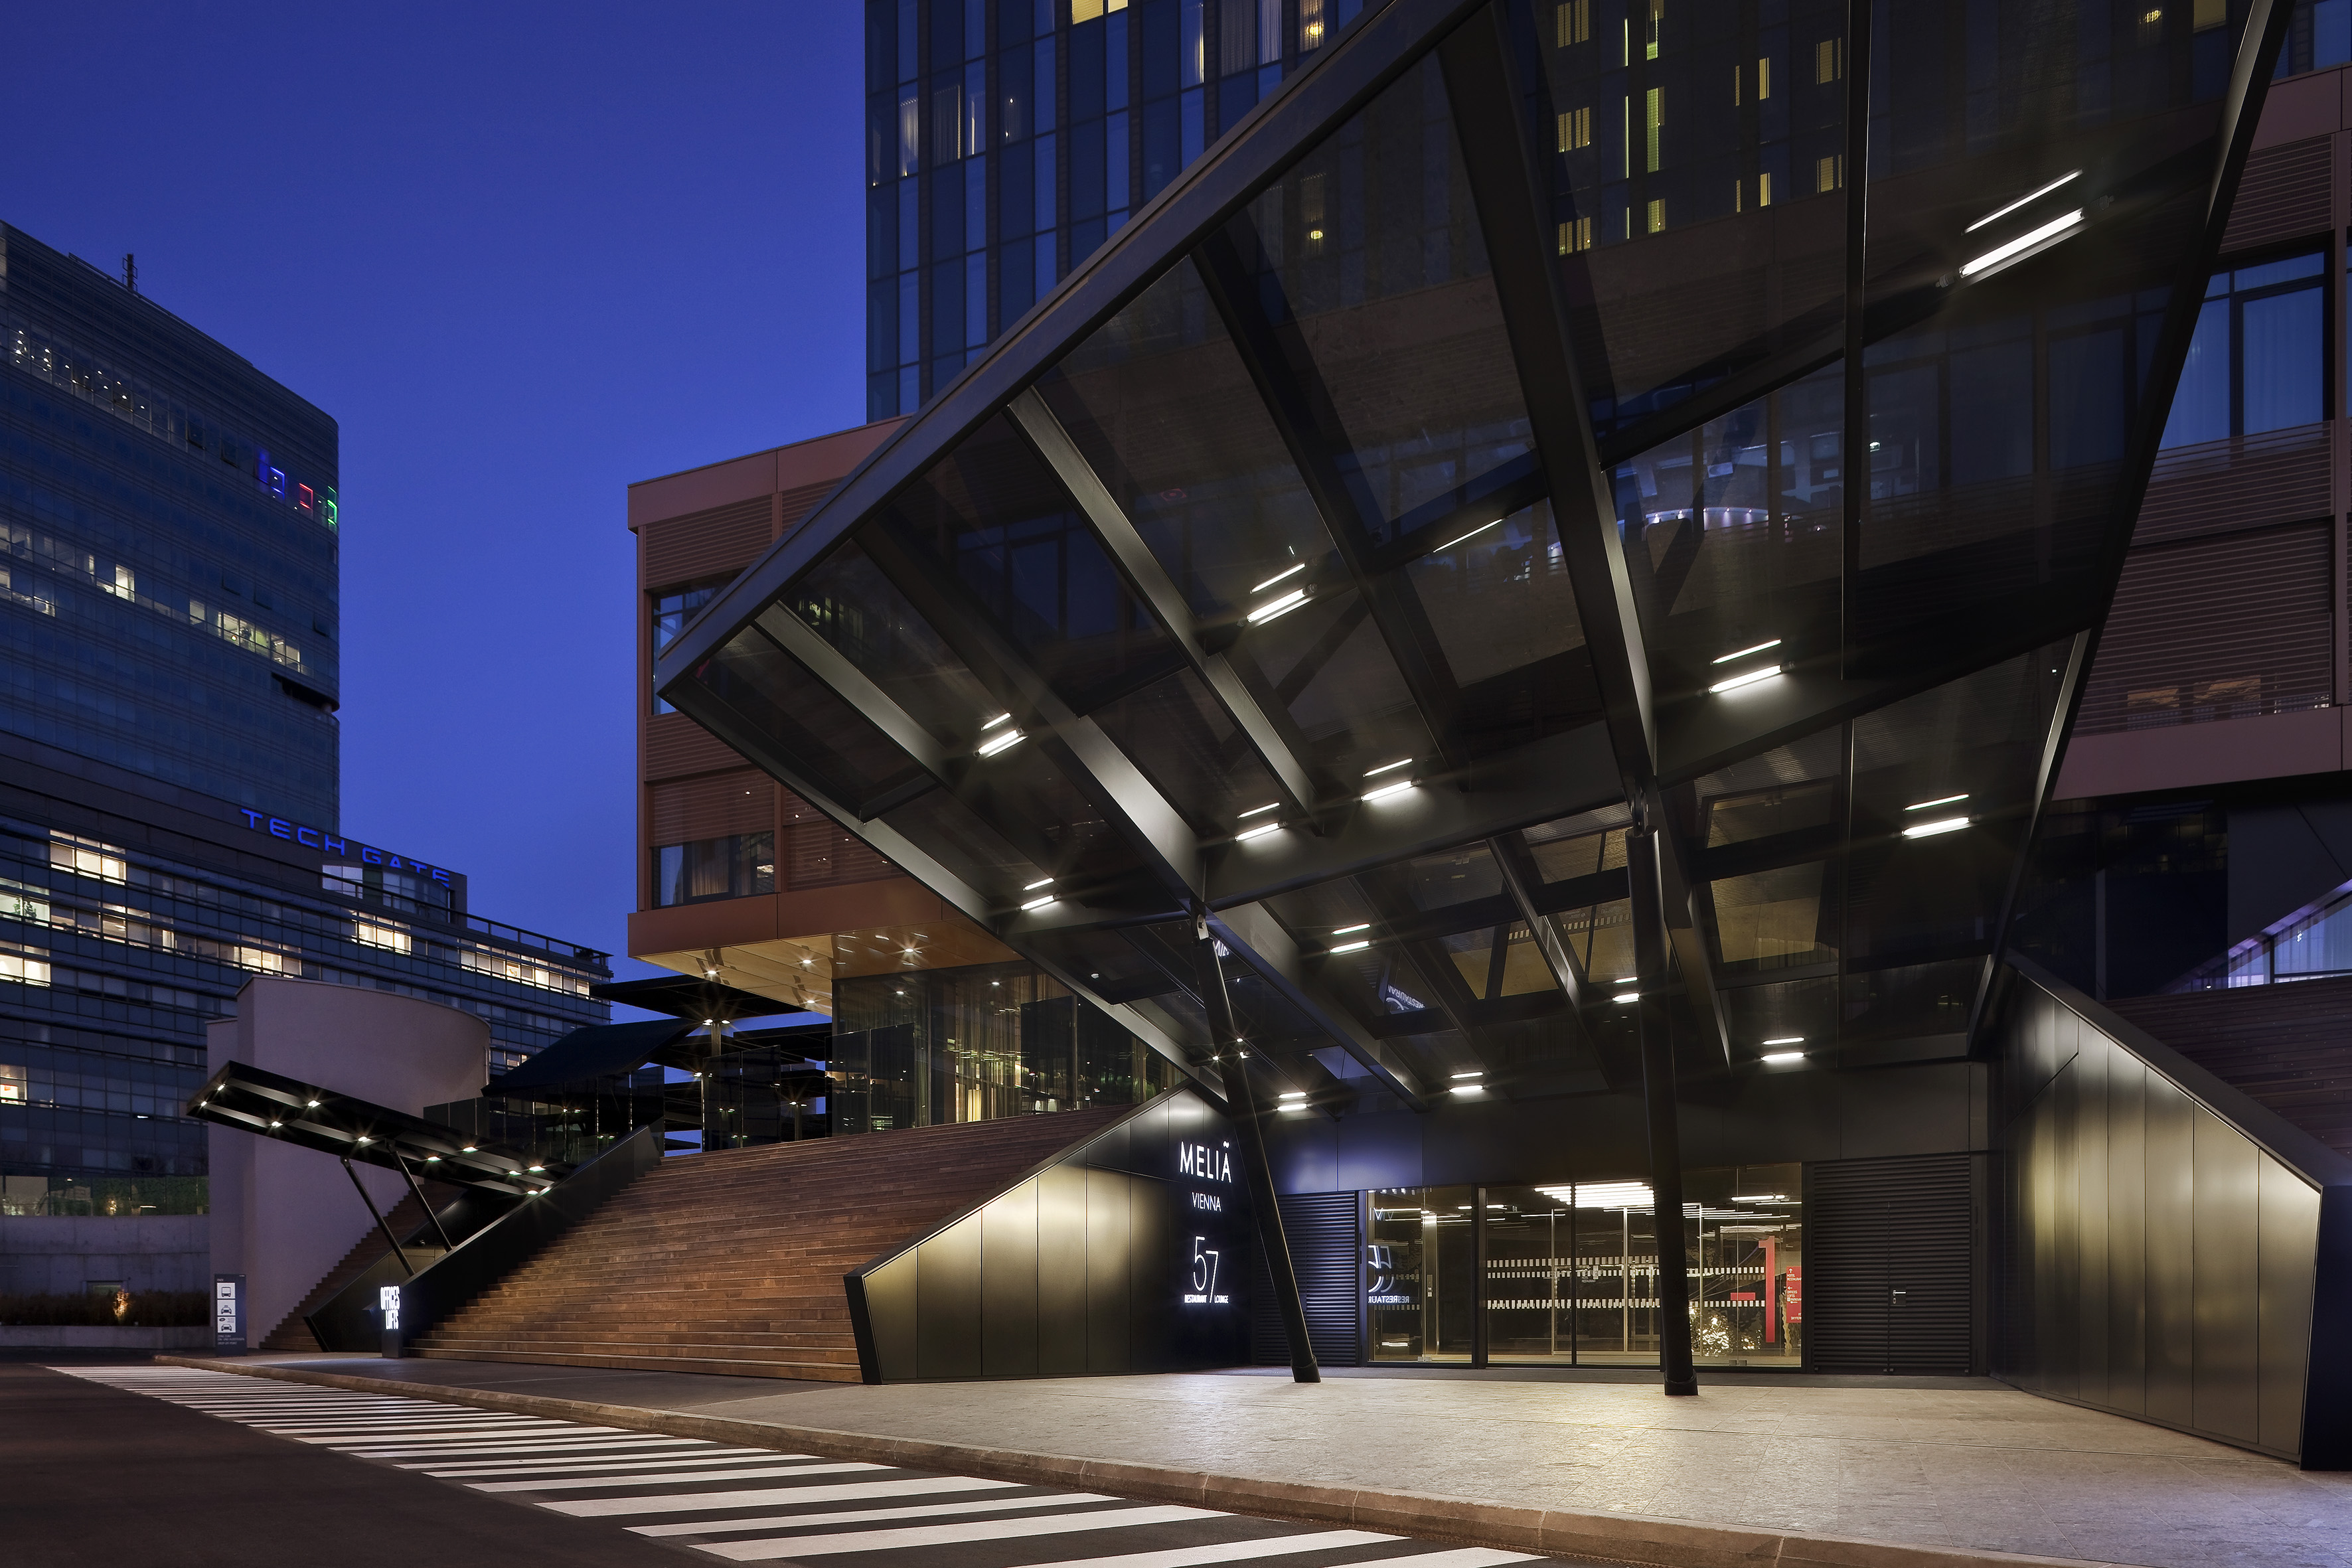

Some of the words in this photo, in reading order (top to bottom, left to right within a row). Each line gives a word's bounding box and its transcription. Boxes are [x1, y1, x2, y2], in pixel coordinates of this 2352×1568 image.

[242, 809, 346, 856] TECH
[362, 846, 449, 888] GATE
[1192, 1192, 1221, 1212] VIENNA
[1194, 1236, 1219, 1302] 57
[380, 1286, 400, 1310] OFFICES
[386, 1310, 399, 1329] LOFTS
